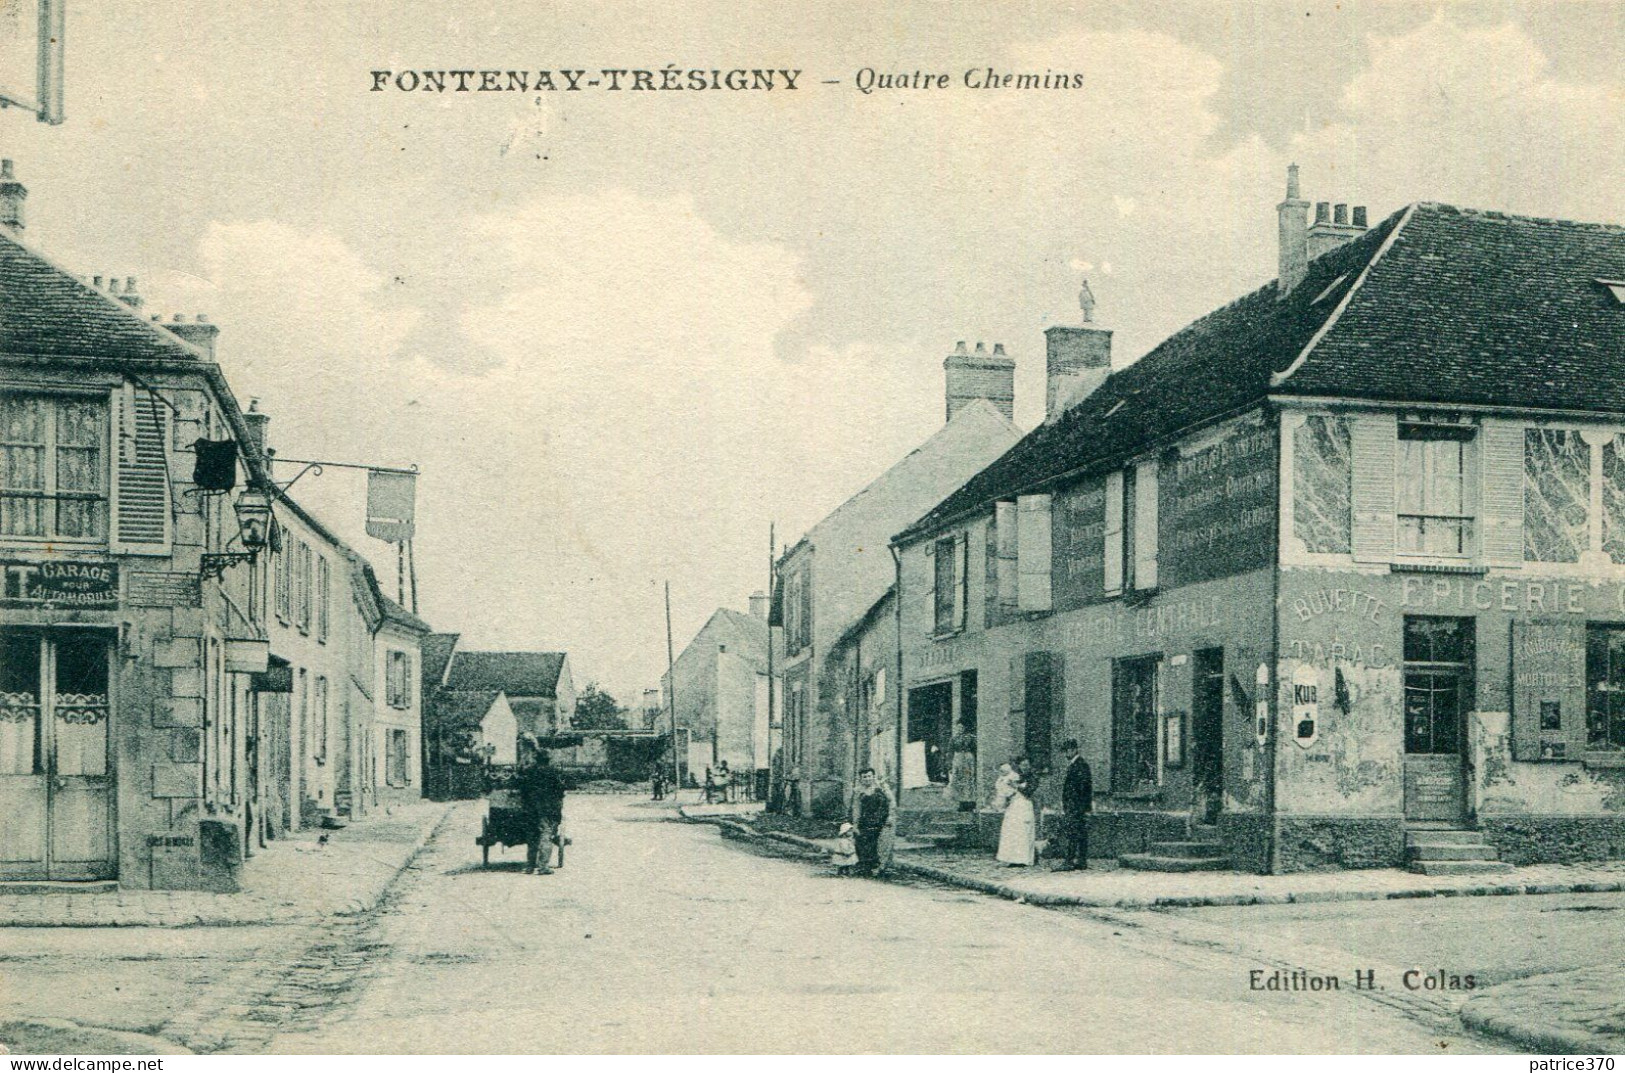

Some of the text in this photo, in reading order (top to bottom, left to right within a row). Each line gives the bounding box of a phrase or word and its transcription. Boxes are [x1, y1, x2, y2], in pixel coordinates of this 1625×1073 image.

[42, 563, 111, 583] GARAGE
[63, 581, 90, 590] POUR
[30, 584, 119, 605] AUTOMOBILES
[1400, 577, 1585, 613] EPICERIE
[1136, 597, 1222, 637] CENTRALE
[1294, 589, 1389, 627] BUVETTE
[1290, 640, 1384, 669] TABAC
[1294, 684, 1317, 705] KUB
